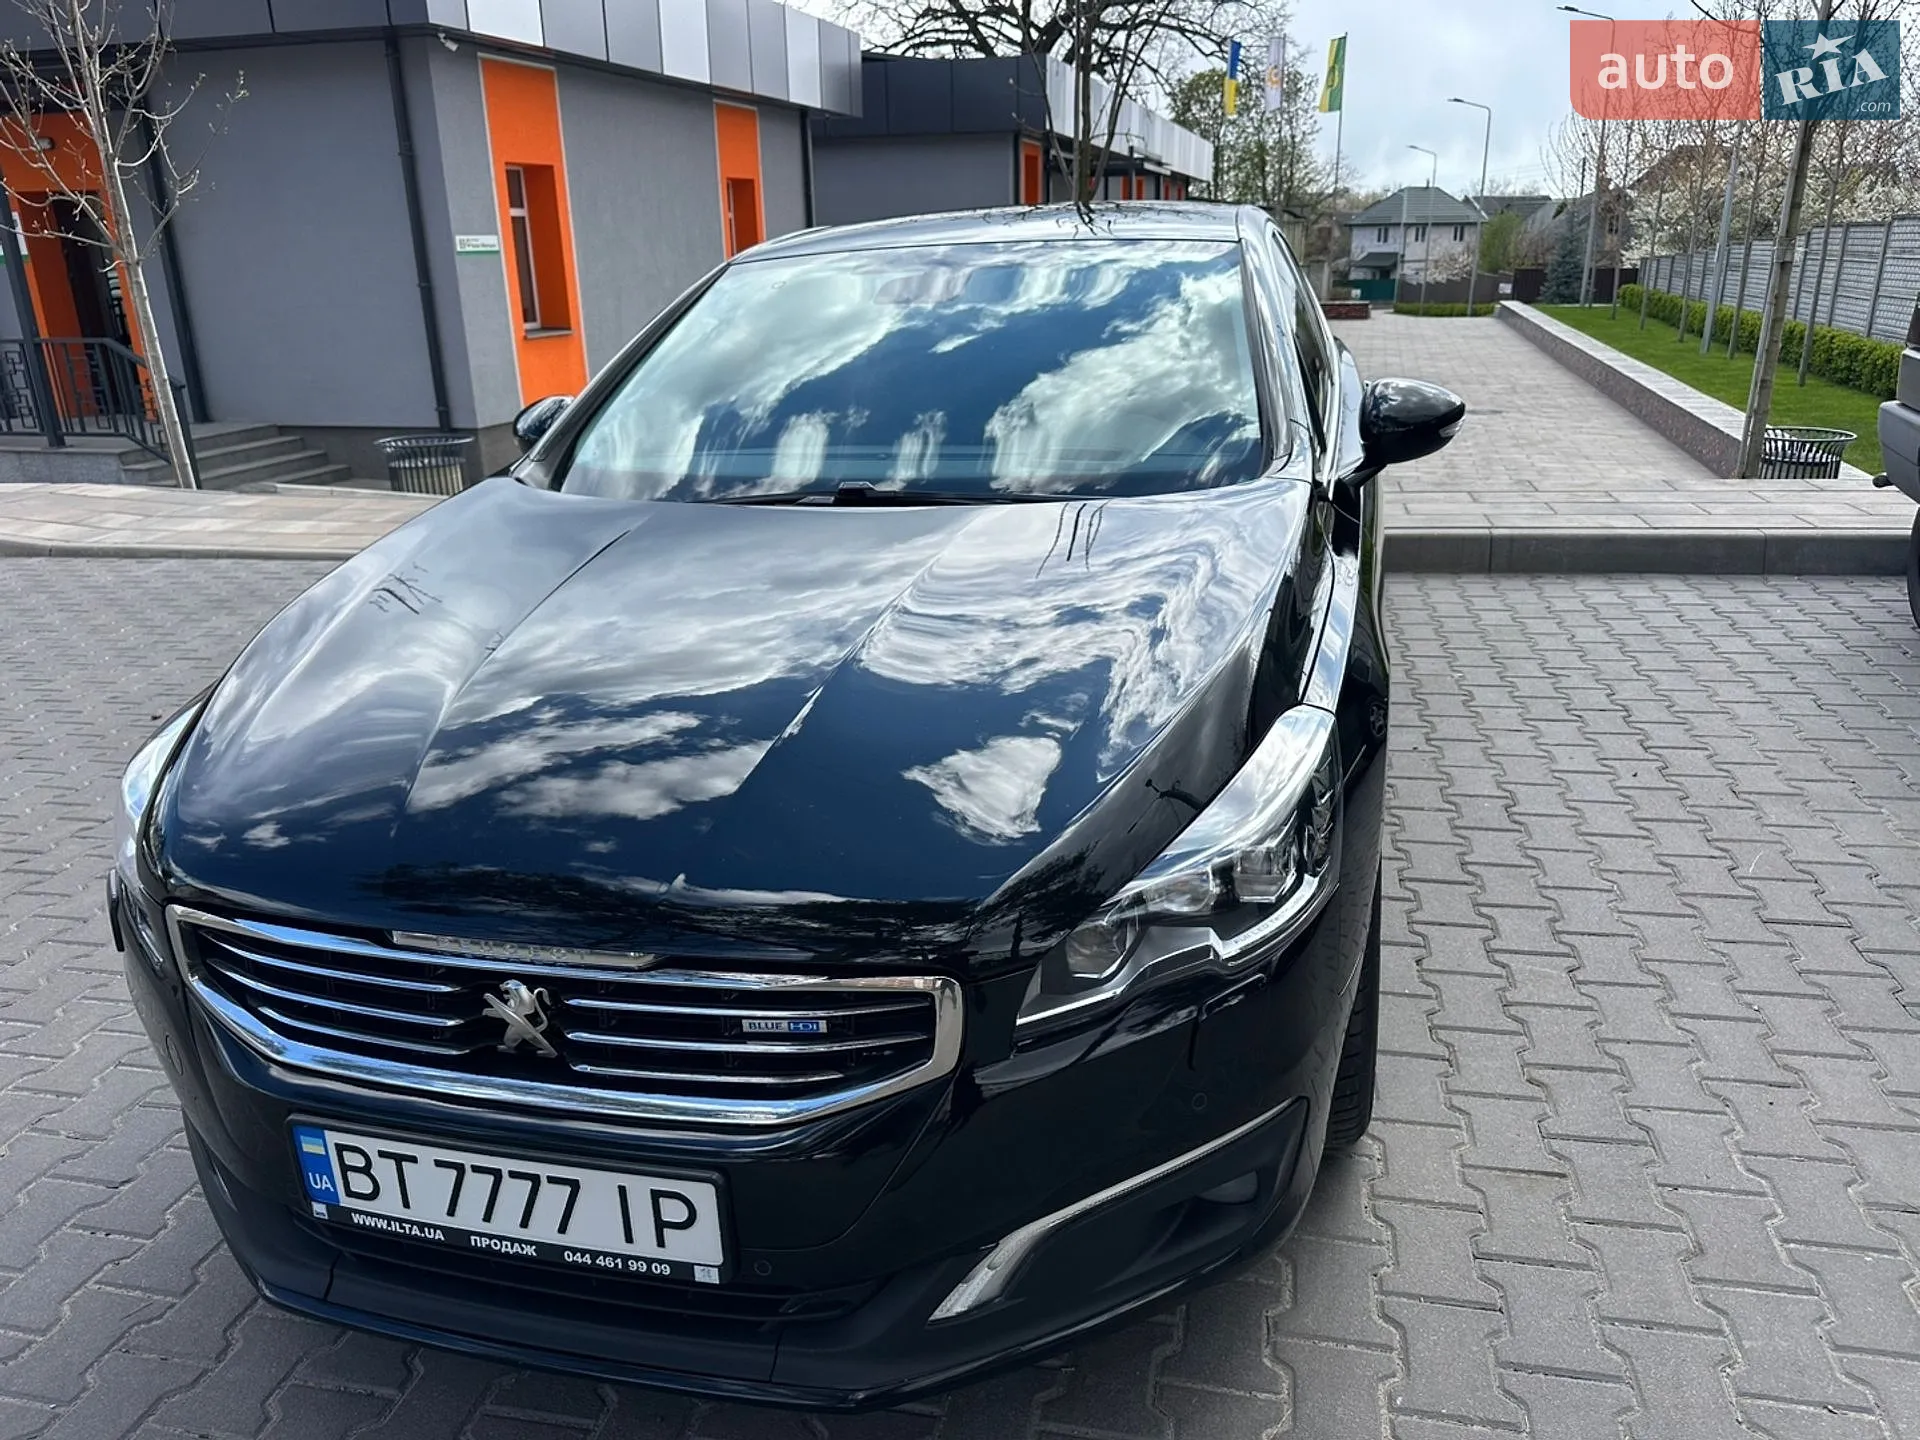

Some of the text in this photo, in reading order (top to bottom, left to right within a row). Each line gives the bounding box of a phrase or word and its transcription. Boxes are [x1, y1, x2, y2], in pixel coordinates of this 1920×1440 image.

[748, 1022, 784, 1031] BLUE
[308, 1172, 335, 1192] UA
[334, 1142, 698, 1249] BT 7777 IP
[351, 1212, 445, 1242] WWW.ILTA.UA
[470, 1235, 538, 1257] ПРОДАЖ
[564, 1250, 671, 1276] 044 461 99 09
